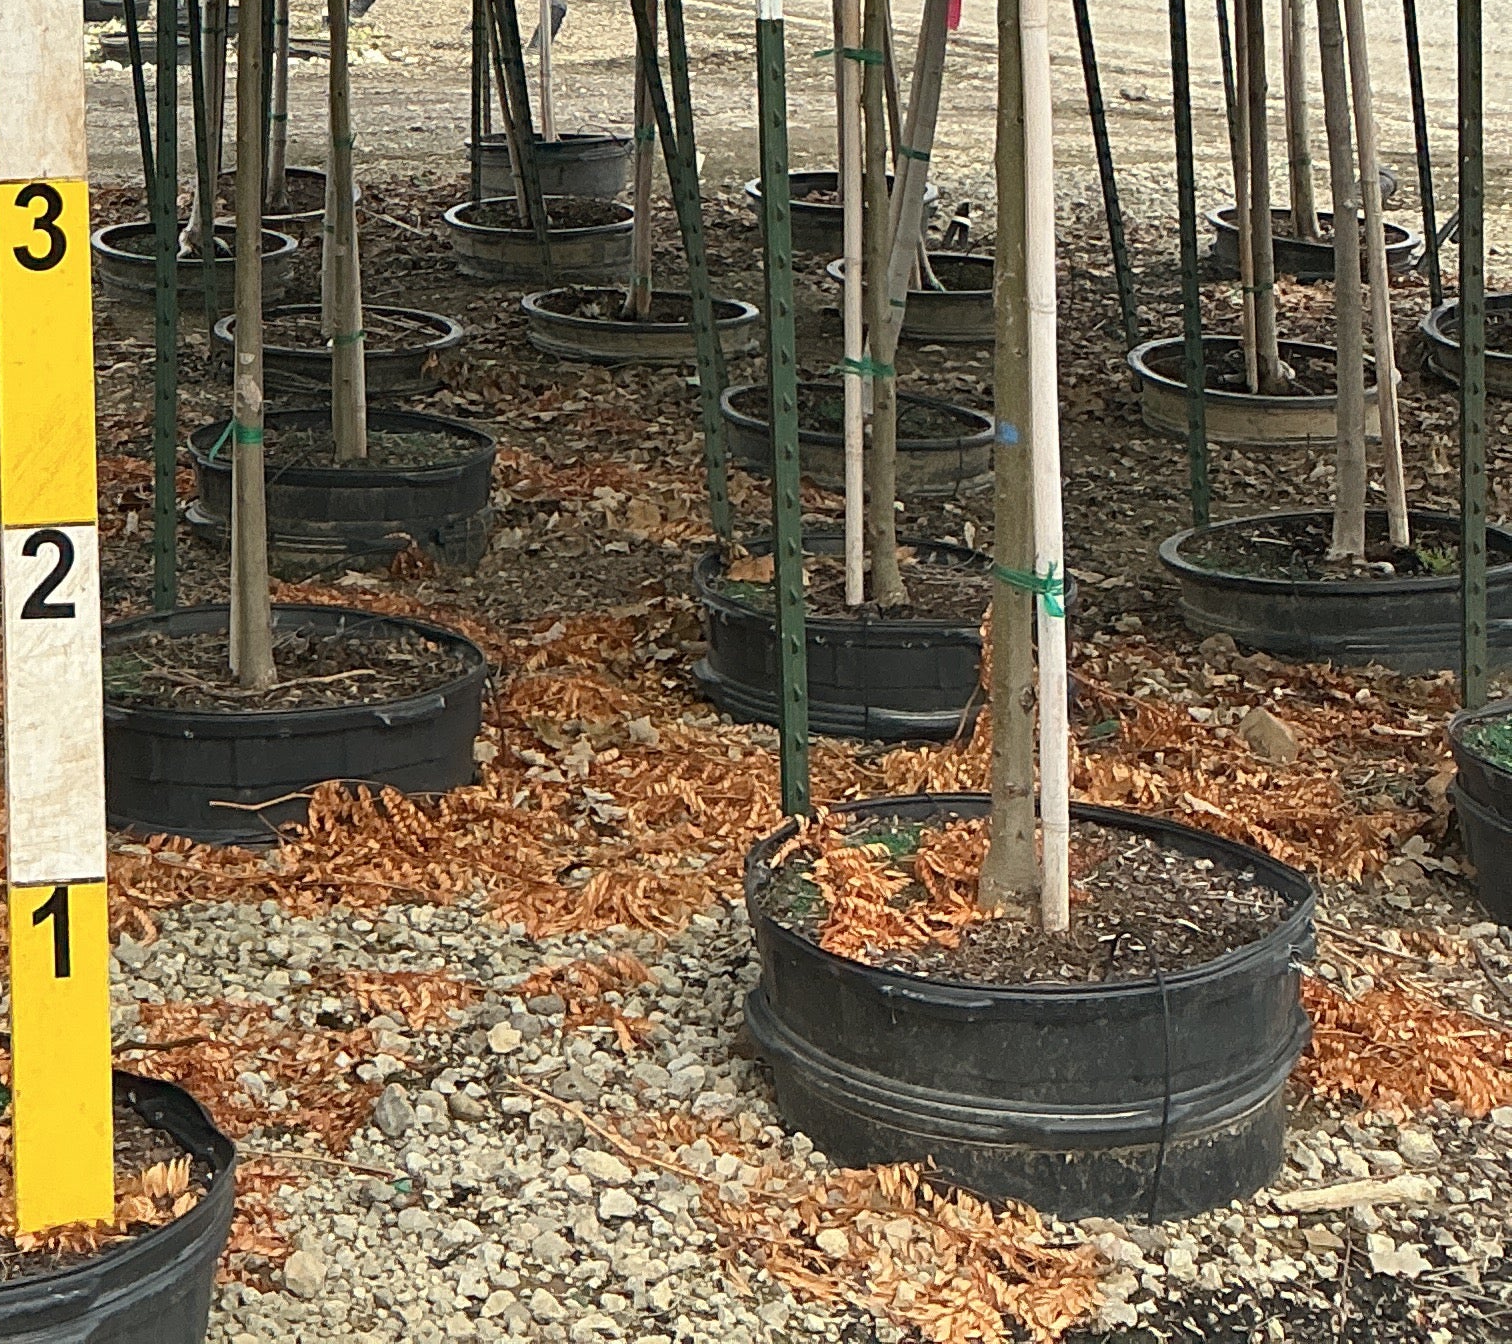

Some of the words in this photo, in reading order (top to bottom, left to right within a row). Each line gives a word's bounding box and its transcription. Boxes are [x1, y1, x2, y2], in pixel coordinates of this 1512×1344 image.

[13, 183, 67, 272] 3
[20, 529, 76, 620] 2
[32, 885, 71, 979] 1
